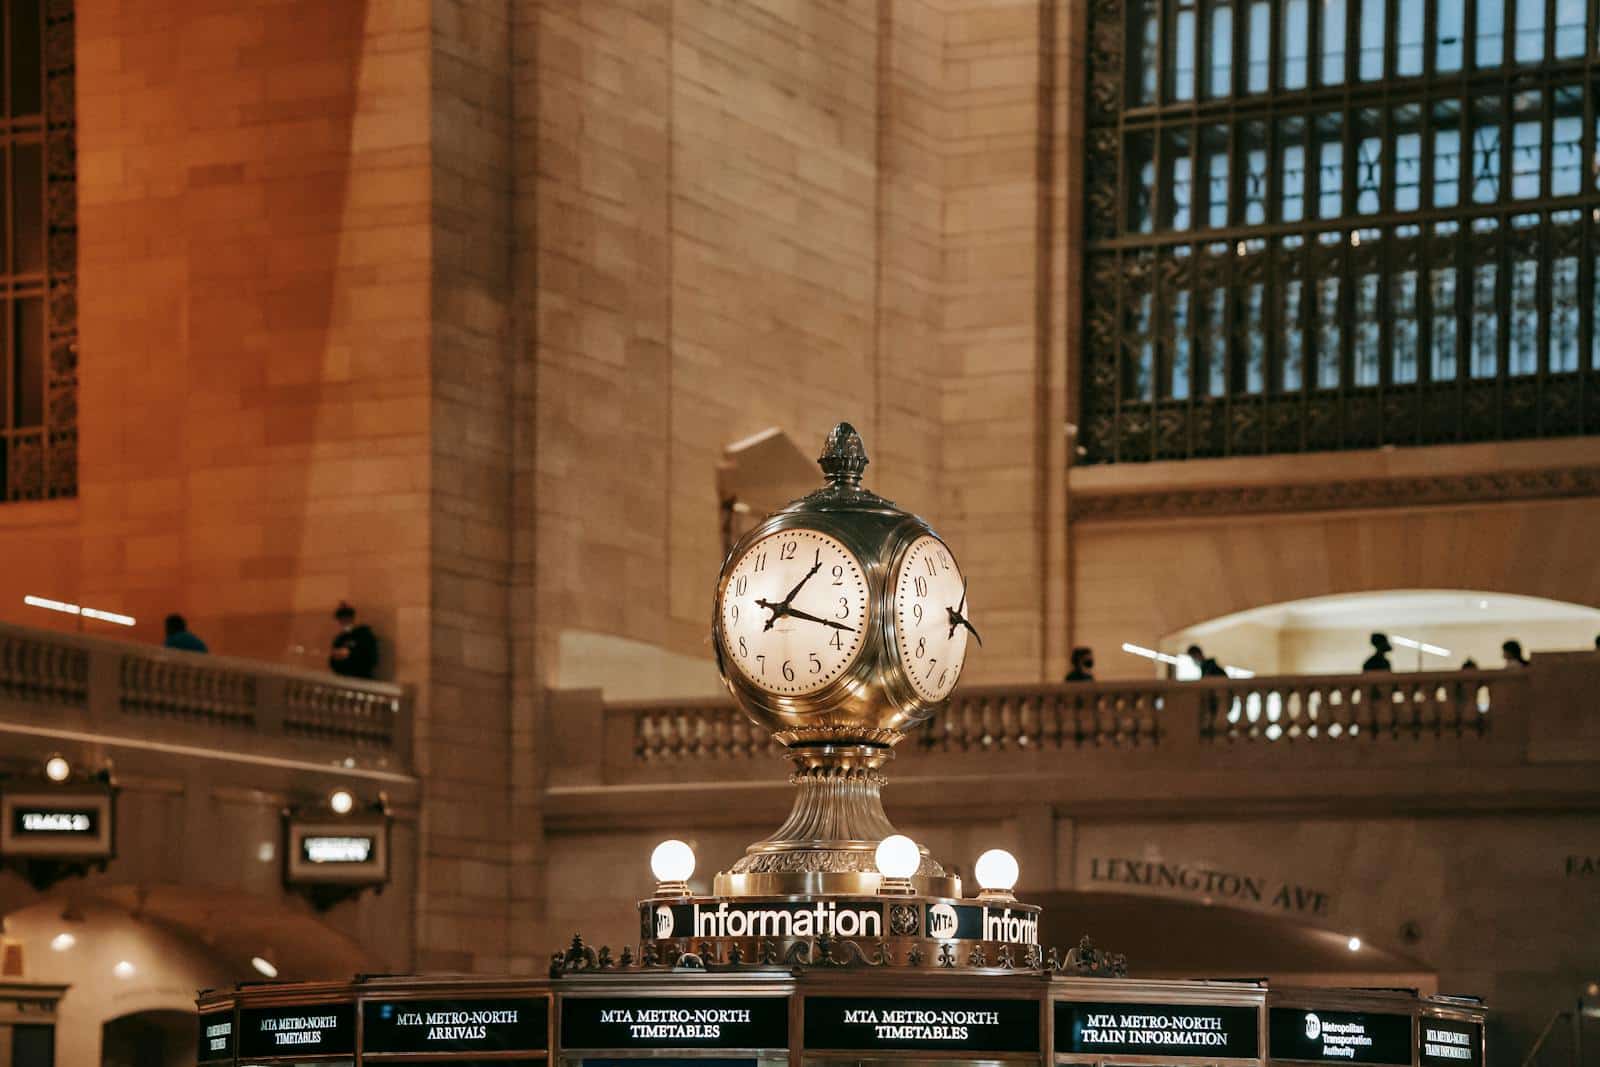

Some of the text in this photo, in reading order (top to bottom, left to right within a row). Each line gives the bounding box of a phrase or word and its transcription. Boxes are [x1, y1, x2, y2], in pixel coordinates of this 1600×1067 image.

[754, 551, 767, 572] 11
[779, 541, 798, 561] 12
[831, 565, 844, 586] 2
[924, 556, 937, 576] 11
[735, 575, 747, 597] 10
[914, 575, 928, 598] 10
[731, 604, 739, 626] 9
[835, 597, 849, 619] 3
[914, 603, 923, 627] 9
[739, 636, 748, 658] 8
[829, 629, 844, 651] 4
[915, 637, 926, 659] 8
[756, 655, 766, 676] 7
[782, 660, 794, 681] 6
[808, 652, 822, 673] 5
[926, 658, 937, 679] 7
[938, 667, 948, 689] 6
[1090, 857, 1328, 914] LEXINGTON AVE
[693, 902, 881, 937] Information
[261, 1015, 337, 1032] MTA METRO-NORTH
[397, 1010, 518, 1026] MTA METRO-NORTH
[600, 1009, 751, 1024] MTA METRO-NORTH
[843, 1010, 1000, 1026] MTA METRO-NORTH
[1087, 1014, 1222, 1031] MTA METRO-NORTH
[275, 1031, 321, 1045] TIMETABLES
[427, 1025, 487, 1040] ARRIVALS
[630, 1024, 720, 1039] TIMETABLES
[875, 1025, 969, 1041] TIMETABLES
[1081, 1029, 1228, 1046] TRAIN INFORMATION
[1322, 1021, 1365, 1036] Metropolitan
[1322, 1033, 1372, 1047] Transportation
[1323, 1045, 1355, 1059] Authority
